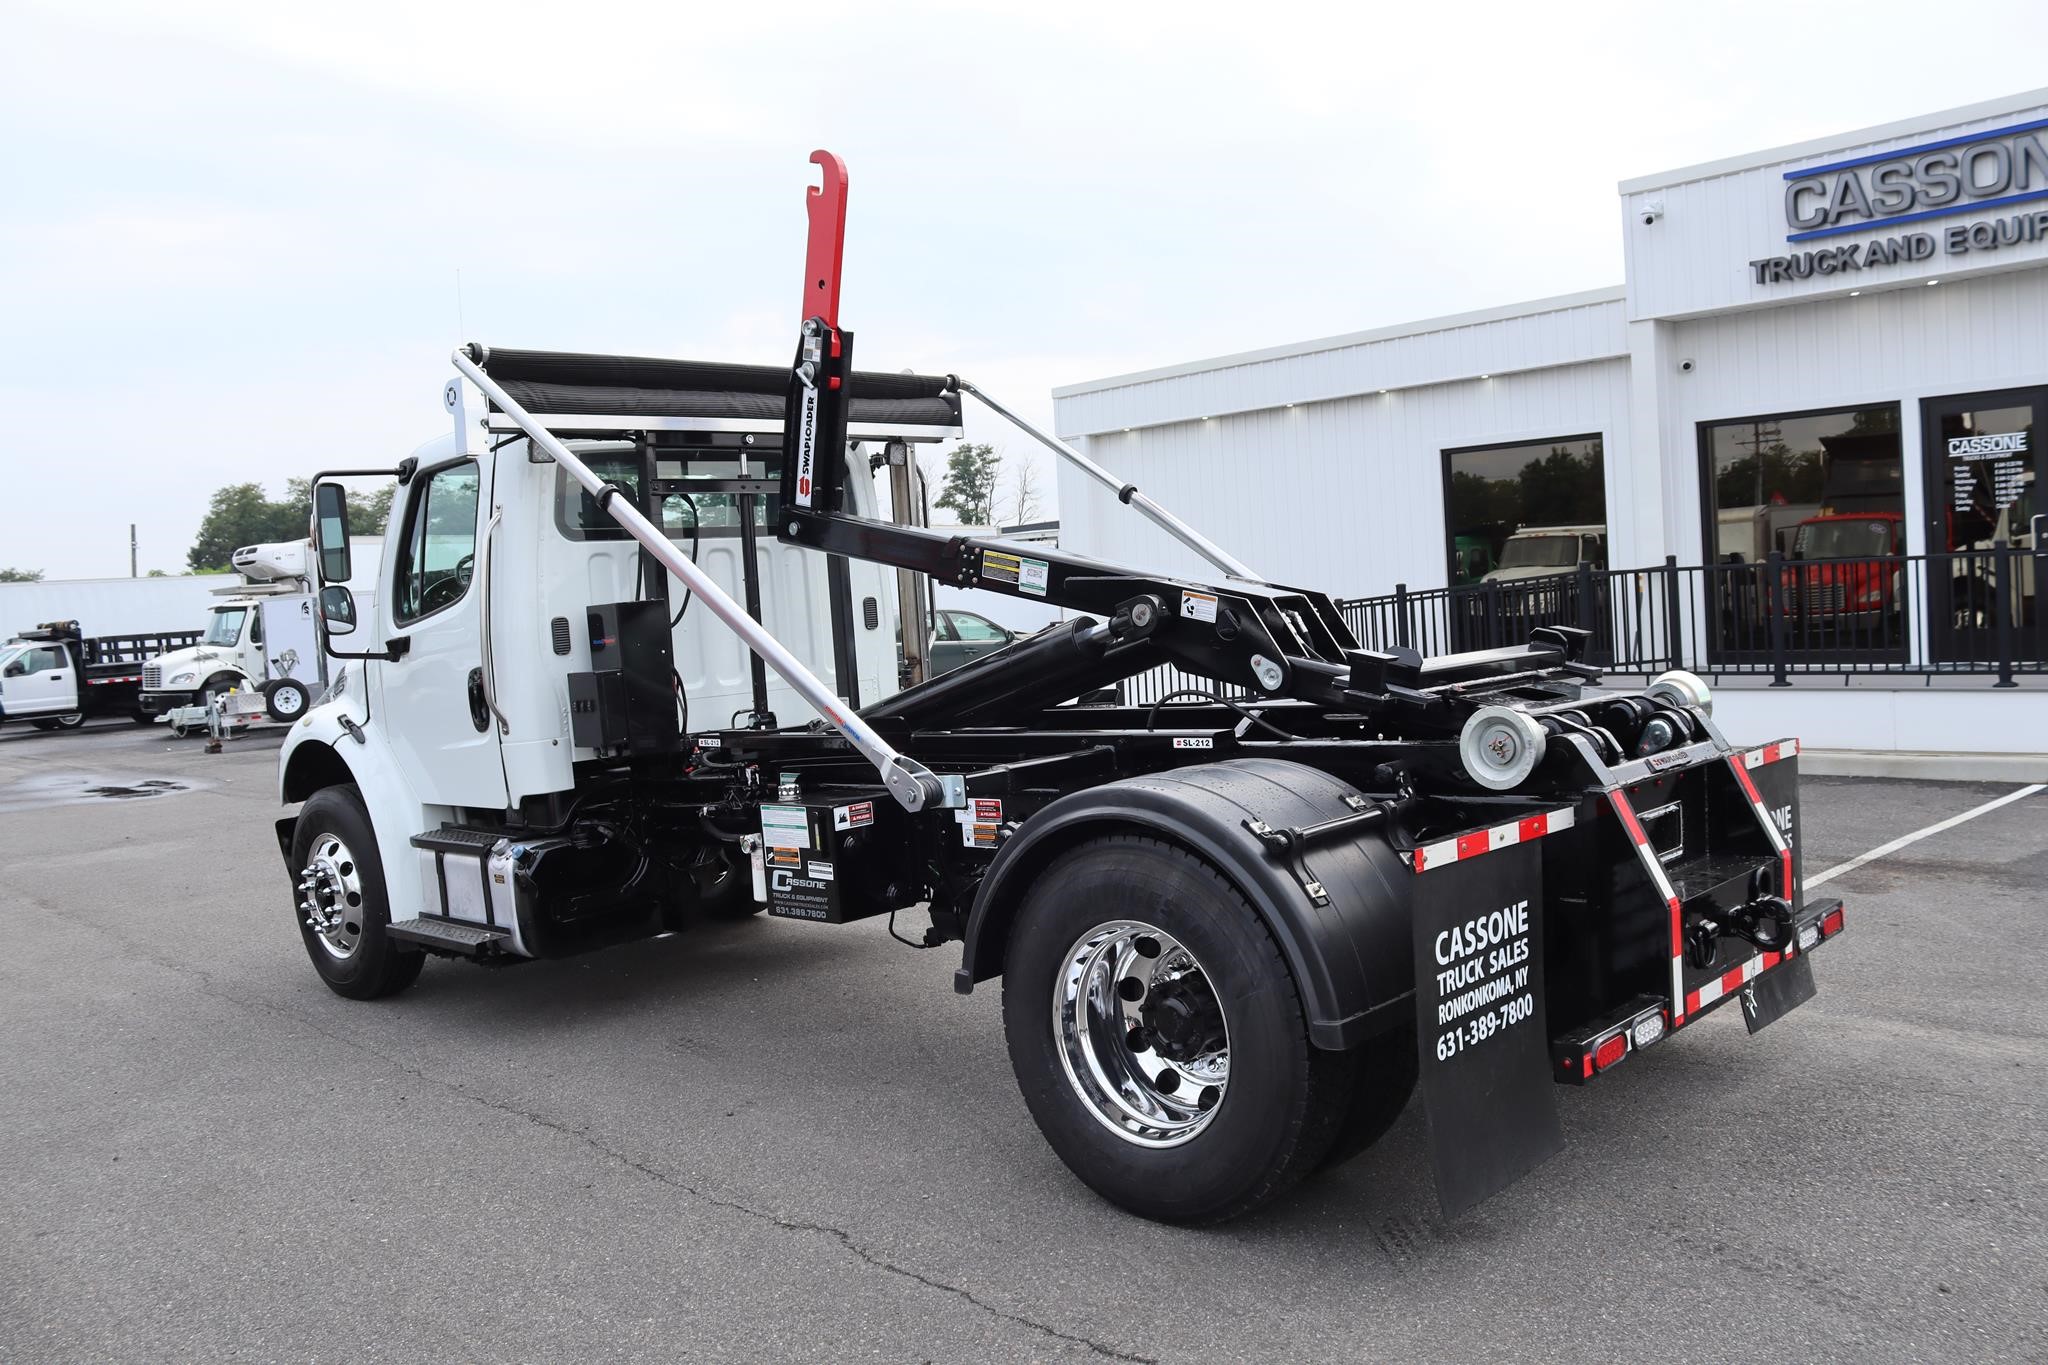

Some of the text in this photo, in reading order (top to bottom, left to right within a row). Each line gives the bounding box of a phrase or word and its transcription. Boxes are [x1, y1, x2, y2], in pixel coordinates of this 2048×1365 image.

[1785, 134, 2048, 230] CASSON
[1750, 243, 1862, 284] TRUCK
[1863, 232, 1936, 267] AND
[802, 396, 815, 475] SWAPLOADER
[1948, 434, 2027, 454] CASSONE
[1182, 739, 1210, 747] SL-212
[773, 892, 791, 900] TRUCK
[1435, 899, 1529, 966] CASSONE
[1437, 938, 1529, 996] TRUCK SALES
[1438, 965, 1529, 1026] RONKONKOMA, NY
[1436, 993, 1534, 1061] 631-389-7800
